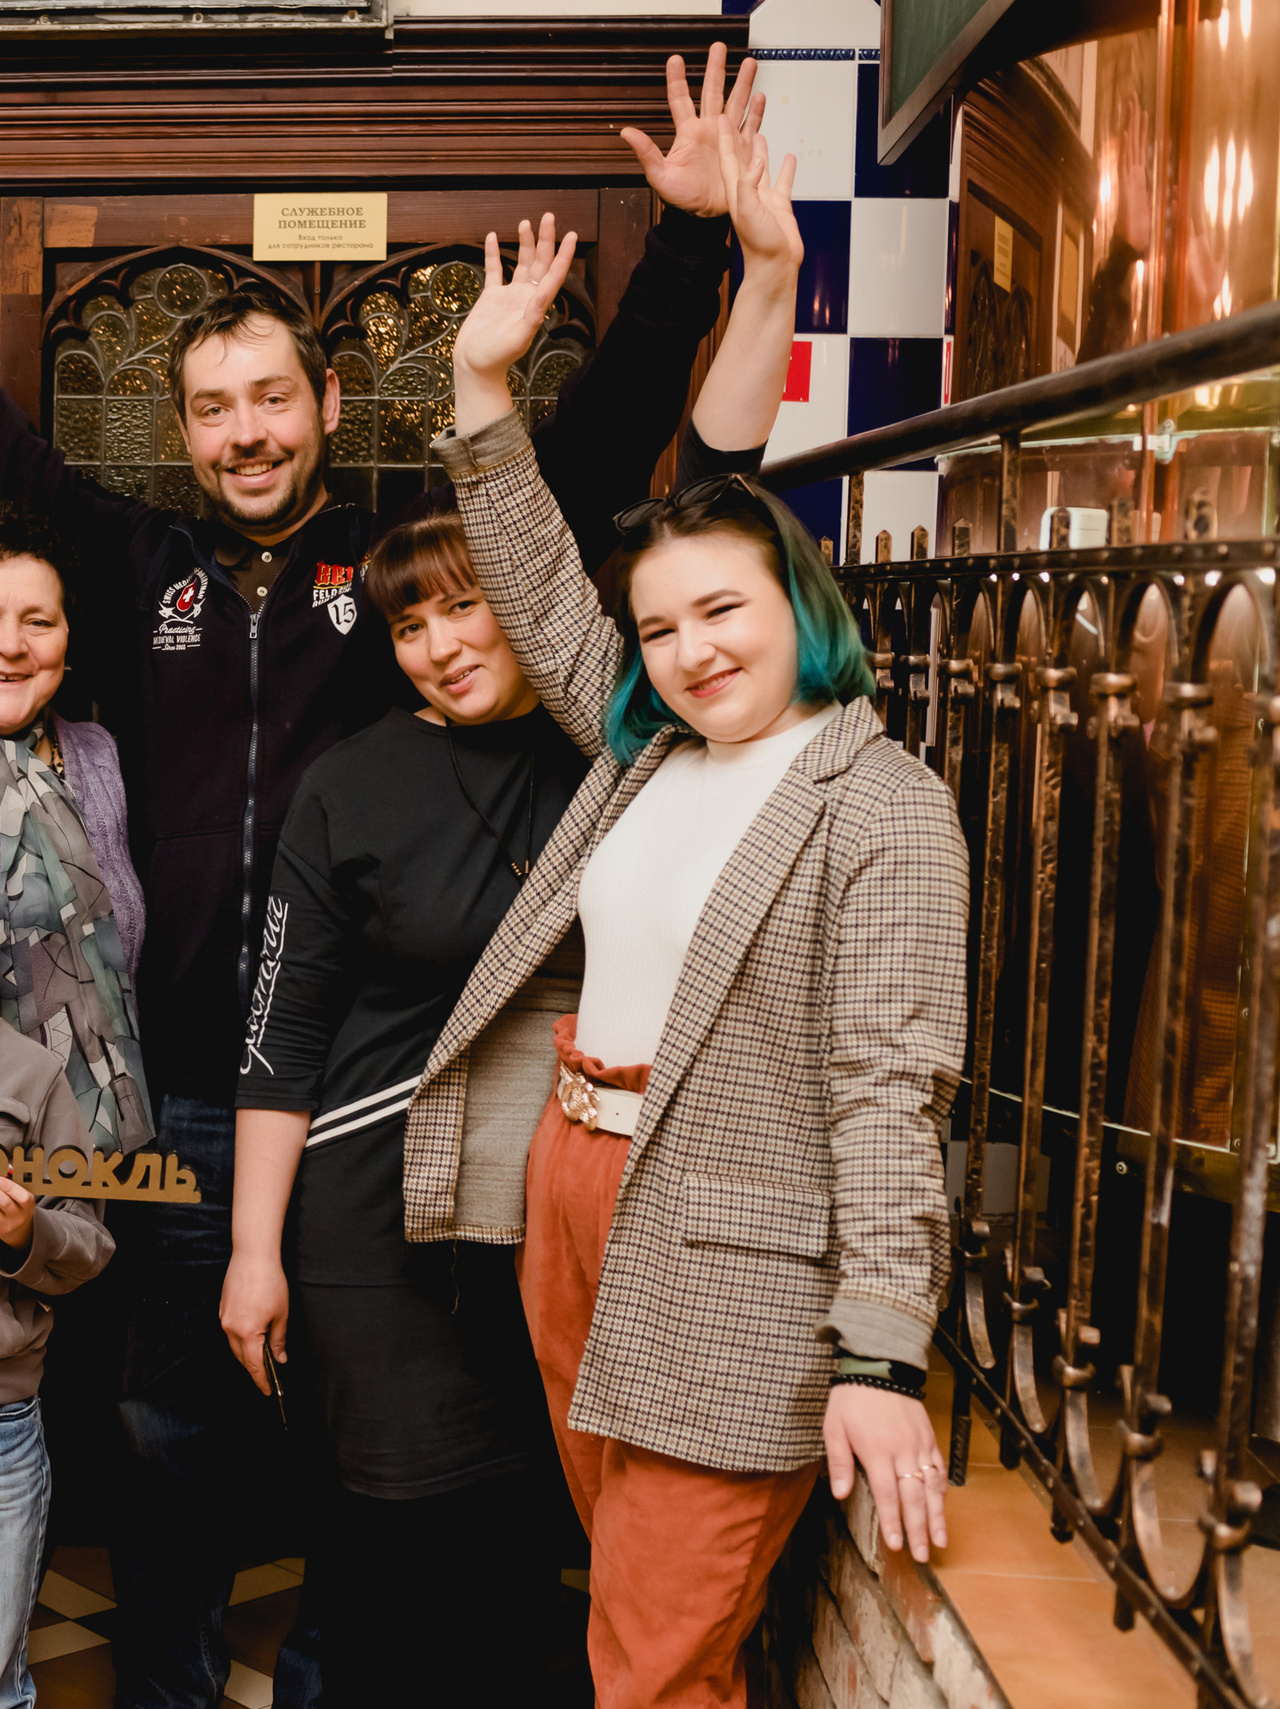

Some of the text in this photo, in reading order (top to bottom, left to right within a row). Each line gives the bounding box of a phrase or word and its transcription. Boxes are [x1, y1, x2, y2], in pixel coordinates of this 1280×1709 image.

[281, 207, 364, 217] СЛУЖЕБНОЕ
[278, 219, 366, 230] ПОМЕЩЕНИЕ
[162, 586, 176, 604] SWISS
[332, 602, 355, 626] 15
[176, 633, 201, 644] VIOLENCE
